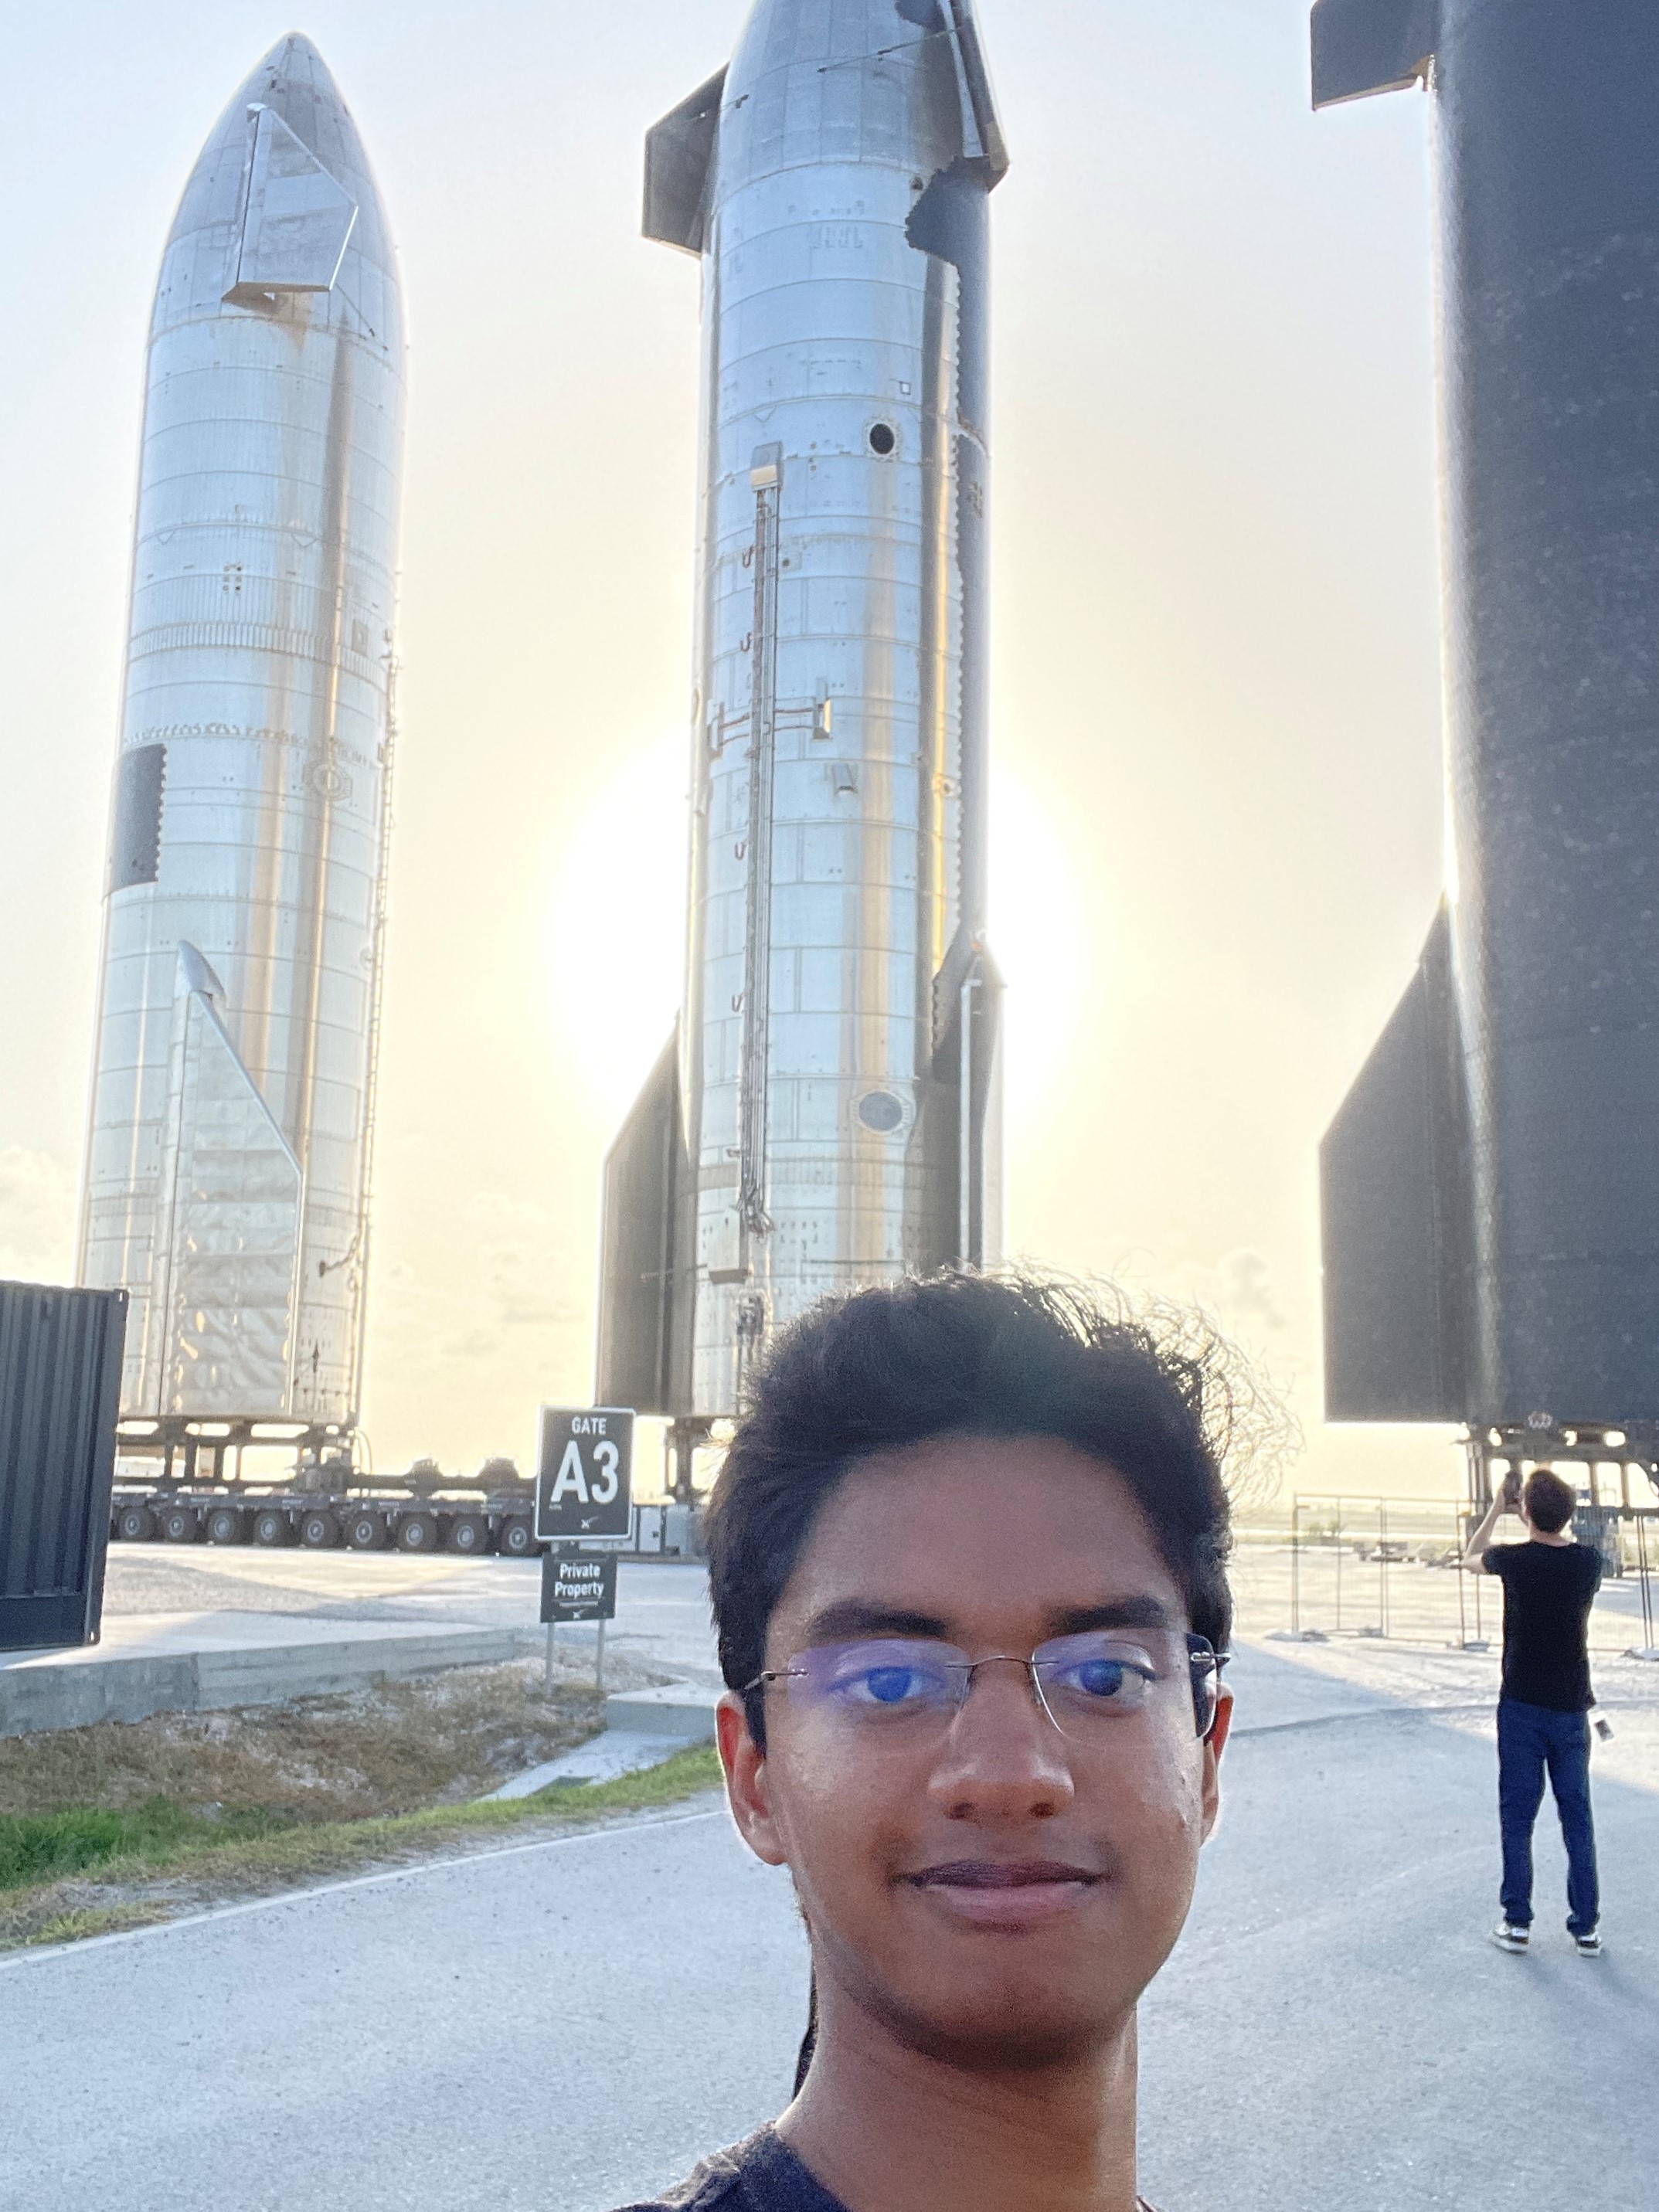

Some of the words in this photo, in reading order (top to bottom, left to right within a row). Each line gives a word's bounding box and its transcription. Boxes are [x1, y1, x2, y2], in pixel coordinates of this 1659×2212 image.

[572, 1417, 607, 1435] GATE
[550, 1440, 619, 1504] A3
[560, 1563, 600, 1578] Private
[555, 1581, 604, 1599] Property
